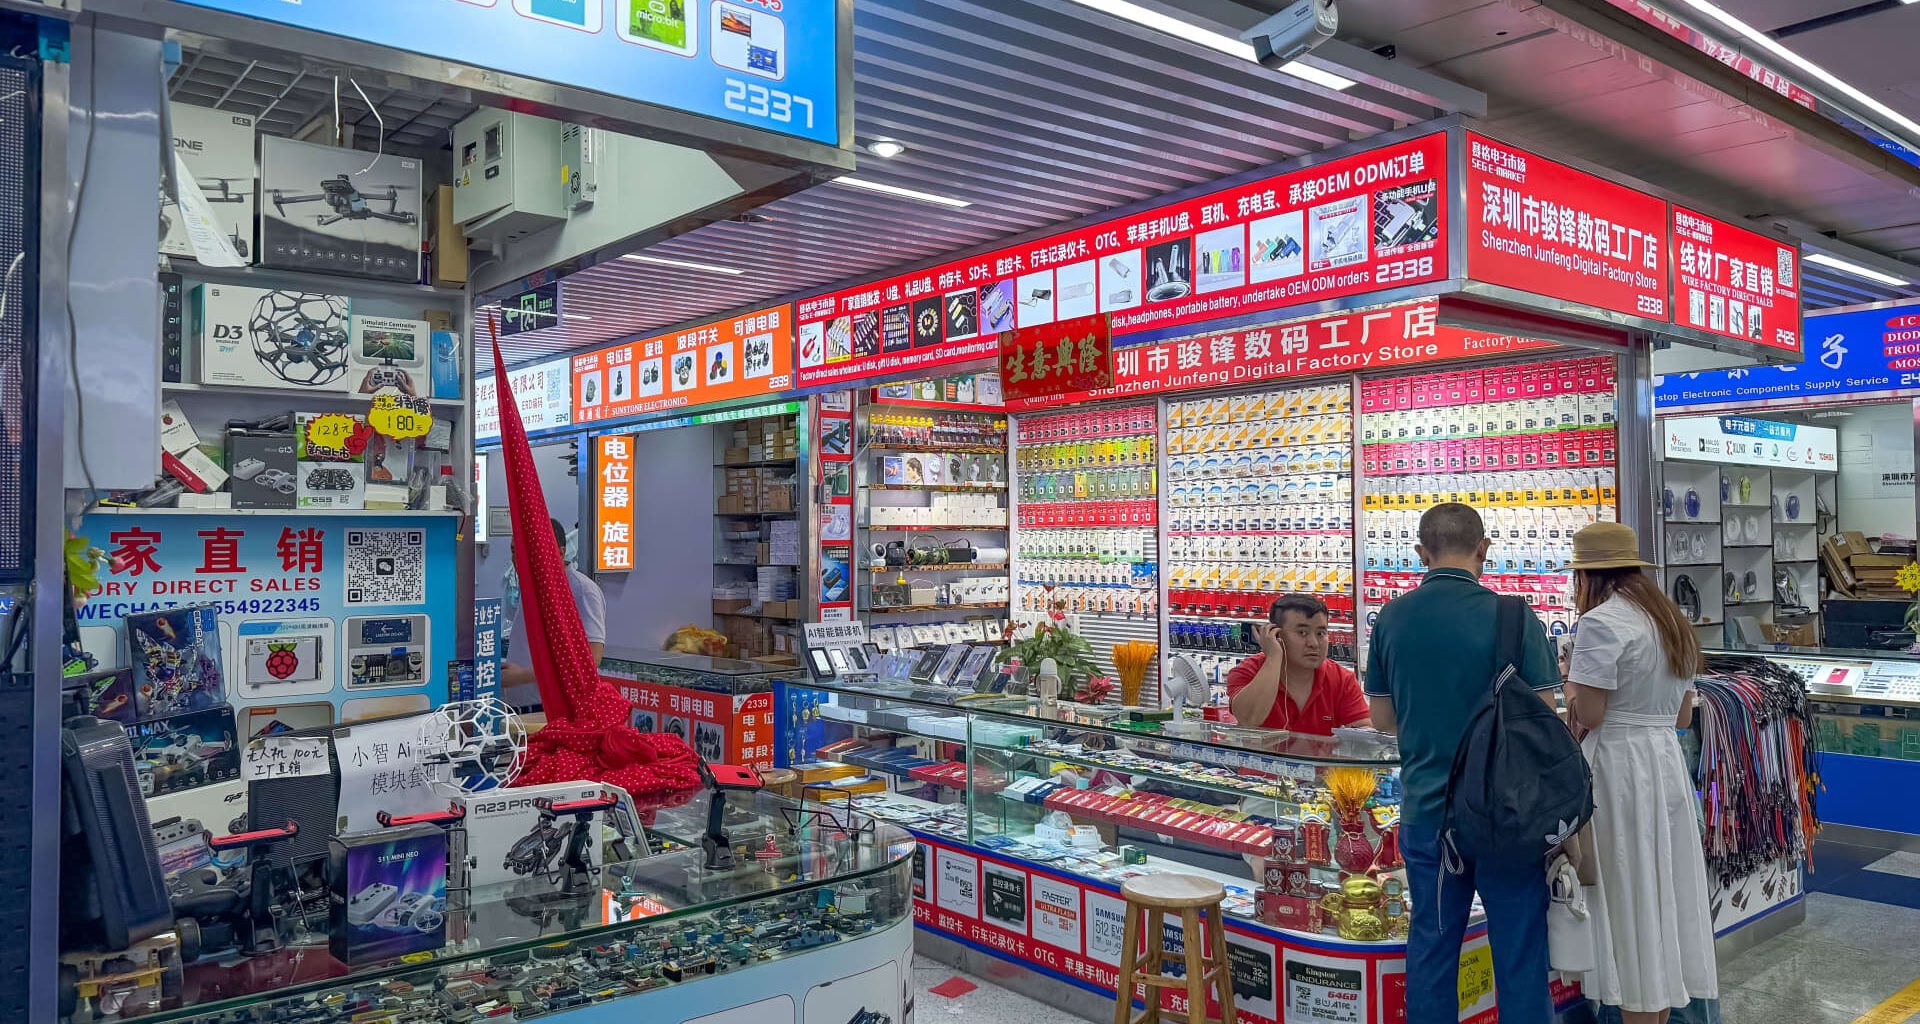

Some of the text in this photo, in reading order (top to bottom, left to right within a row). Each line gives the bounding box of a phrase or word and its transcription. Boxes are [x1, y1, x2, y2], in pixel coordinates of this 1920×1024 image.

[636, 10, 679, 29] micro:bit
[724, 77, 813, 129] 2337
[1472, 141, 1527, 173] 赛格电子市场
[1472, 158, 1526, 184] SEG E-MARKET
[1482, 181, 1658, 271] 深圳市骏锋数码工厂店
[1482, 229, 1657, 290] Shenzhen Junfeng Digital Factory Store
[1680, 240, 1774, 297] 线材厂家直销
[1375, 257, 1433, 283] 2338
[1176, 299, 1207, 319] portable
[1209, 293, 1240, 314] battery,
[1242, 286, 1285, 307] undertake
[1288, 280, 1309, 297] OEM
[1311, 274, 1336, 293] ODM
[1338, 268, 1369, 288] orders
[1681, 275, 1774, 308] WIRE FACTORY DIRECT SALES
[1638, 294, 1663, 315] 2338
[212, 324, 243, 341] D3
[734, 311, 781, 336] 可调电阻
[1464, 336, 1512, 350] Factory
[1776, 328, 1795, 346] 2425
[1006, 332, 1103, 384] 生意興隆
[1163, 371, 1229, 392] Junfeng
[1234, 360, 1291, 383] Digital
[1296, 351, 1370, 376] Factory
[1379, 341, 1438, 364] Store
[1682, 388, 1732, 401] Electronic
[1736, 382, 1800, 397] Components
[1805, 379, 1841, 392] Supply
[1846, 375, 1889, 388] Service
[612, 396, 689, 416] SUNSTONE ELECTRONICS
[602, 440, 631, 567] 电位器 旋钮
[152, 578, 237, 595] DIRECT
[250, 577, 321, 593] SALES
[187, 598, 321, 615] 554922345
[808, 625, 862, 639] AI智能翻译机
[669, 694, 714, 719] 可调电阻
[747, 699, 768, 710] 2339
[743, 731, 755, 744] 旋
[352, 741, 411, 768] 小智 Ai
[742, 744, 774, 760] 波段
[475, 801, 507, 814] A23
[391, 853, 405, 862] MINI
[406, 850, 419, 860] NEO
[1042, 890, 1071, 907] FASTER
[1040, 903, 1057, 914] ULTRA
[1095, 907, 1125, 923] SAMSUN
[1095, 919, 1109, 937] 512
[1163, 927, 1184, 943] AMSU
[1173, 945, 1184, 954] PR
[1295, 974, 1358, 990] ENDURANCE
[1305, 967, 1337, 980] Kingston
[1327, 990, 1358, 1002] 64GB
